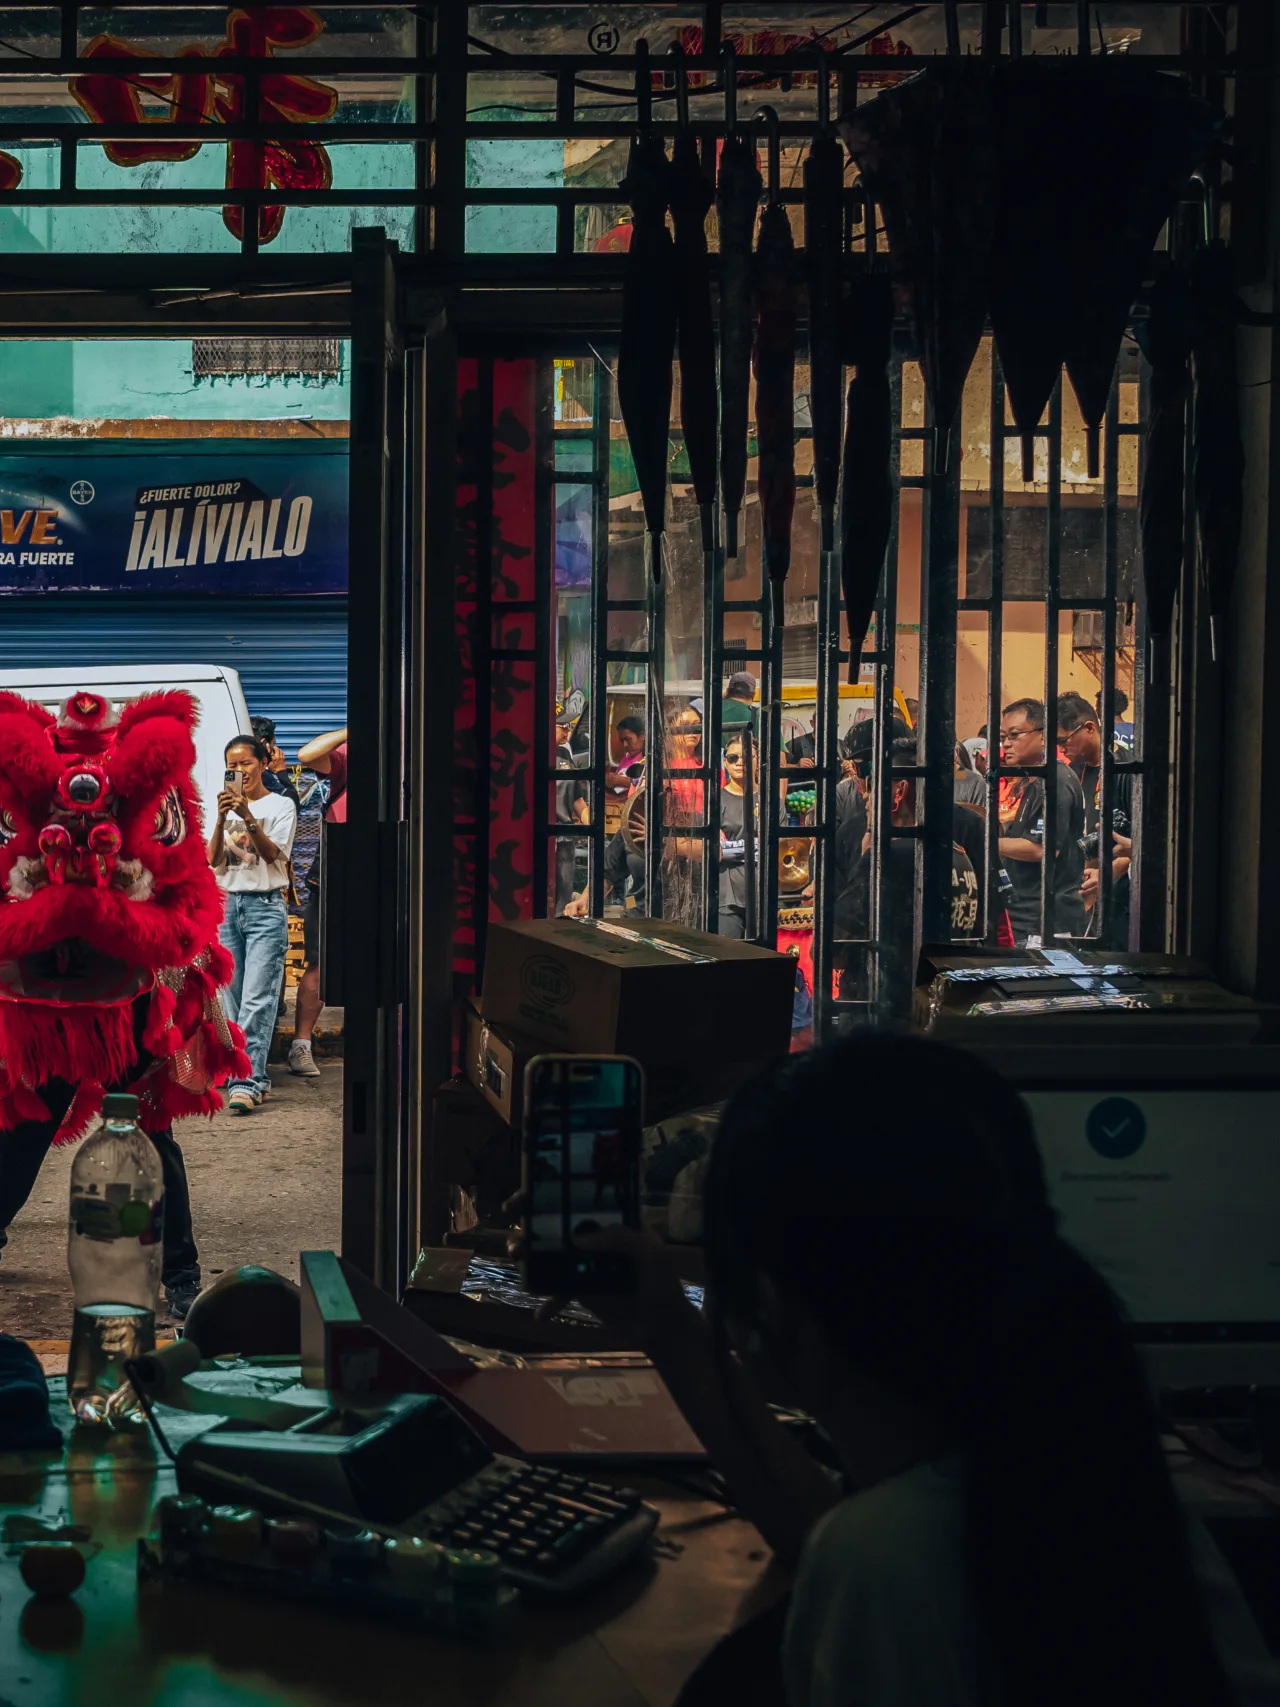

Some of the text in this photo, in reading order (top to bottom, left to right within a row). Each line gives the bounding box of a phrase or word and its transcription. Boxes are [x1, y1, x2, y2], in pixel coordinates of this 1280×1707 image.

[139, 481, 241, 504] ¿FUERTE DOLOR?
[18, 551, 75, 566] FUERTE
